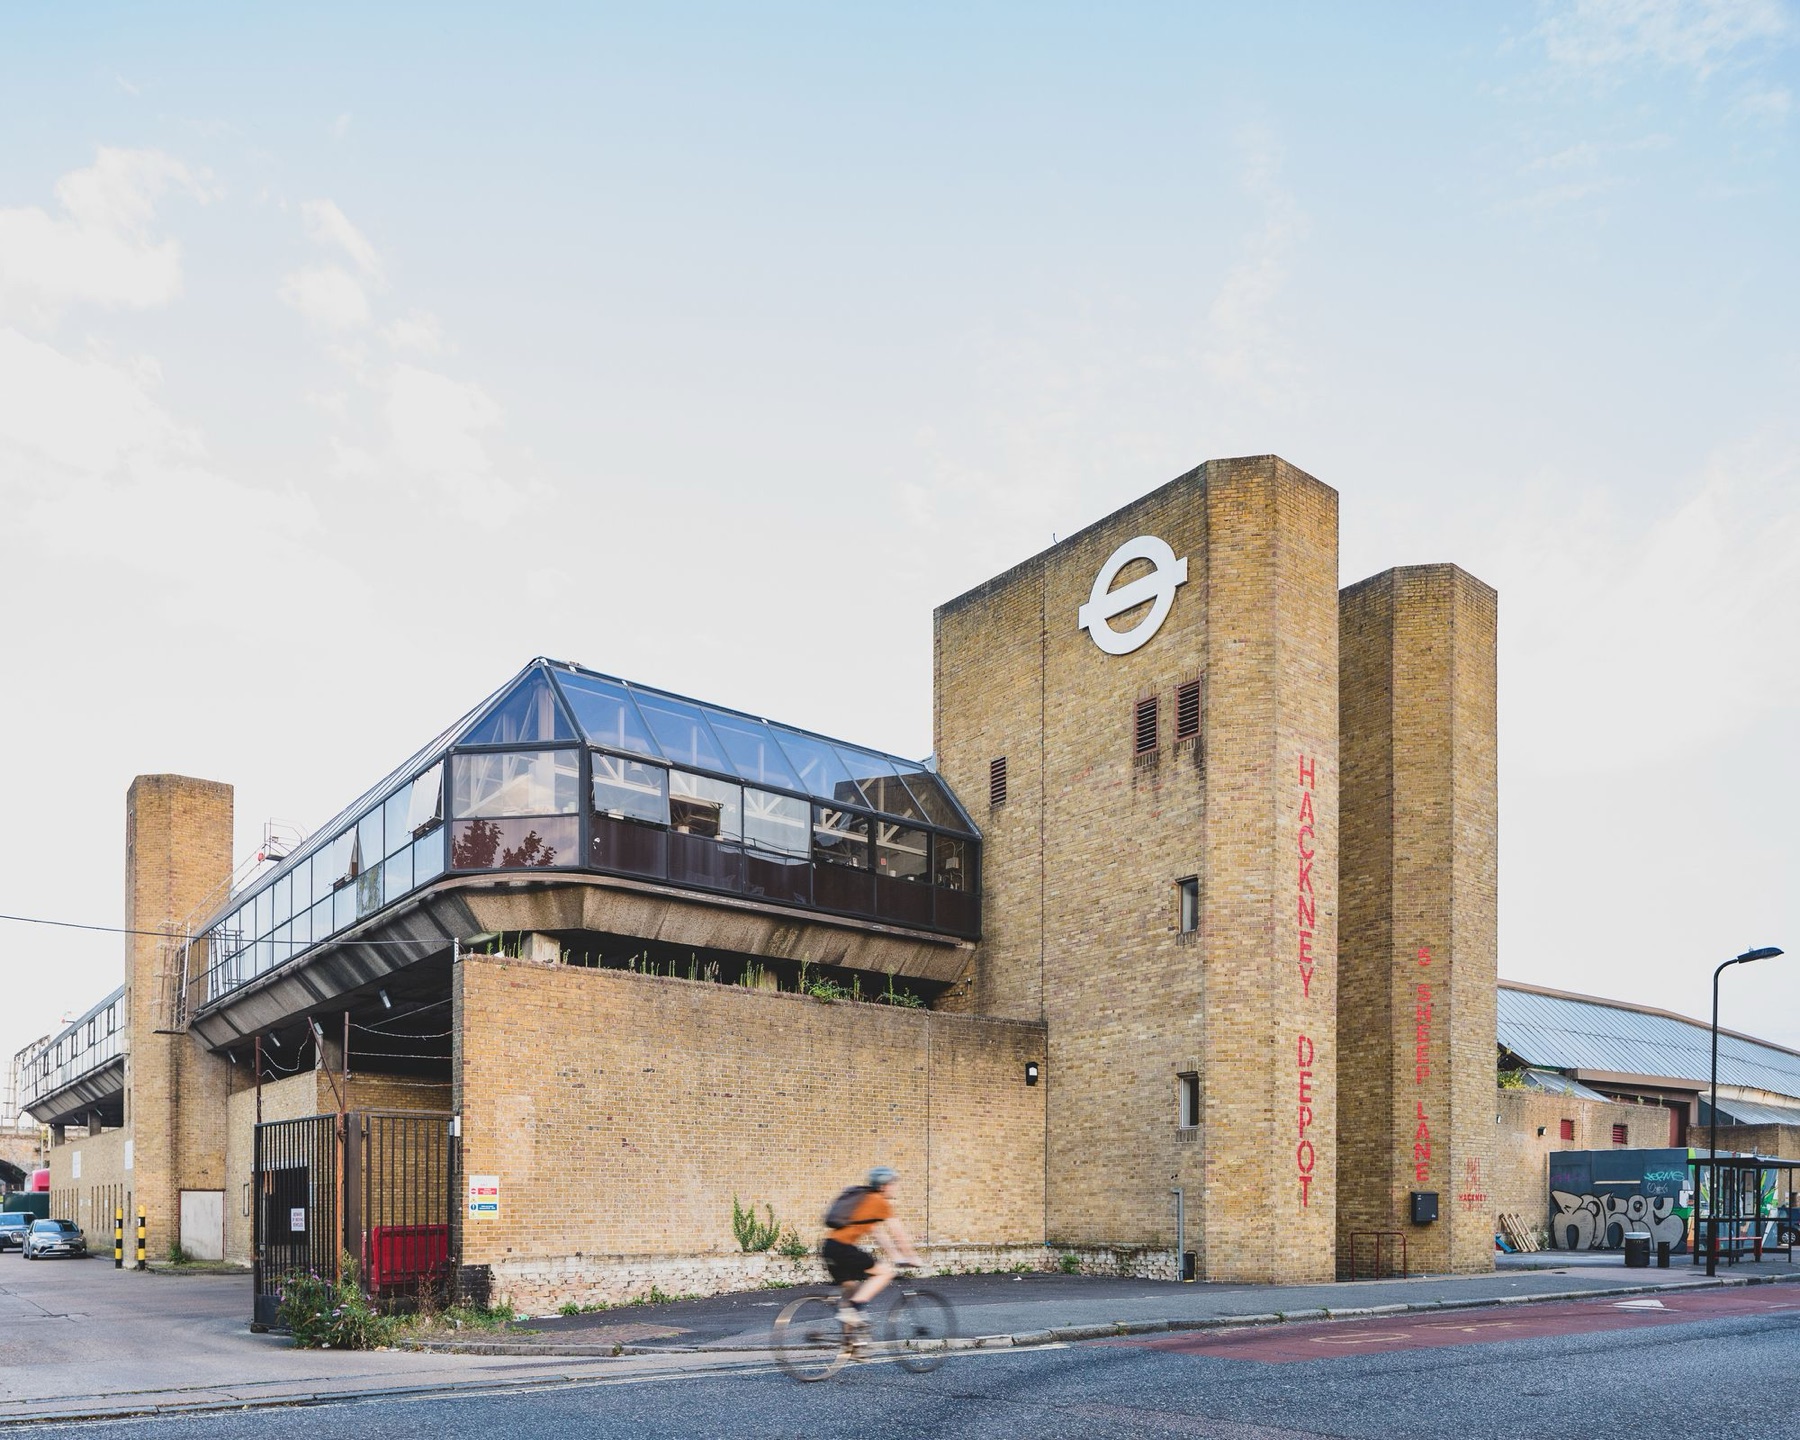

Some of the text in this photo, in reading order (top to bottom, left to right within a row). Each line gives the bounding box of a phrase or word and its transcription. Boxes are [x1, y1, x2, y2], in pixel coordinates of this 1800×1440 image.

[1297, 754, 1315, 1208] HACKNEY DEPOT
[1415, 947, 1431, 1182] 5 SHEEP LANE
